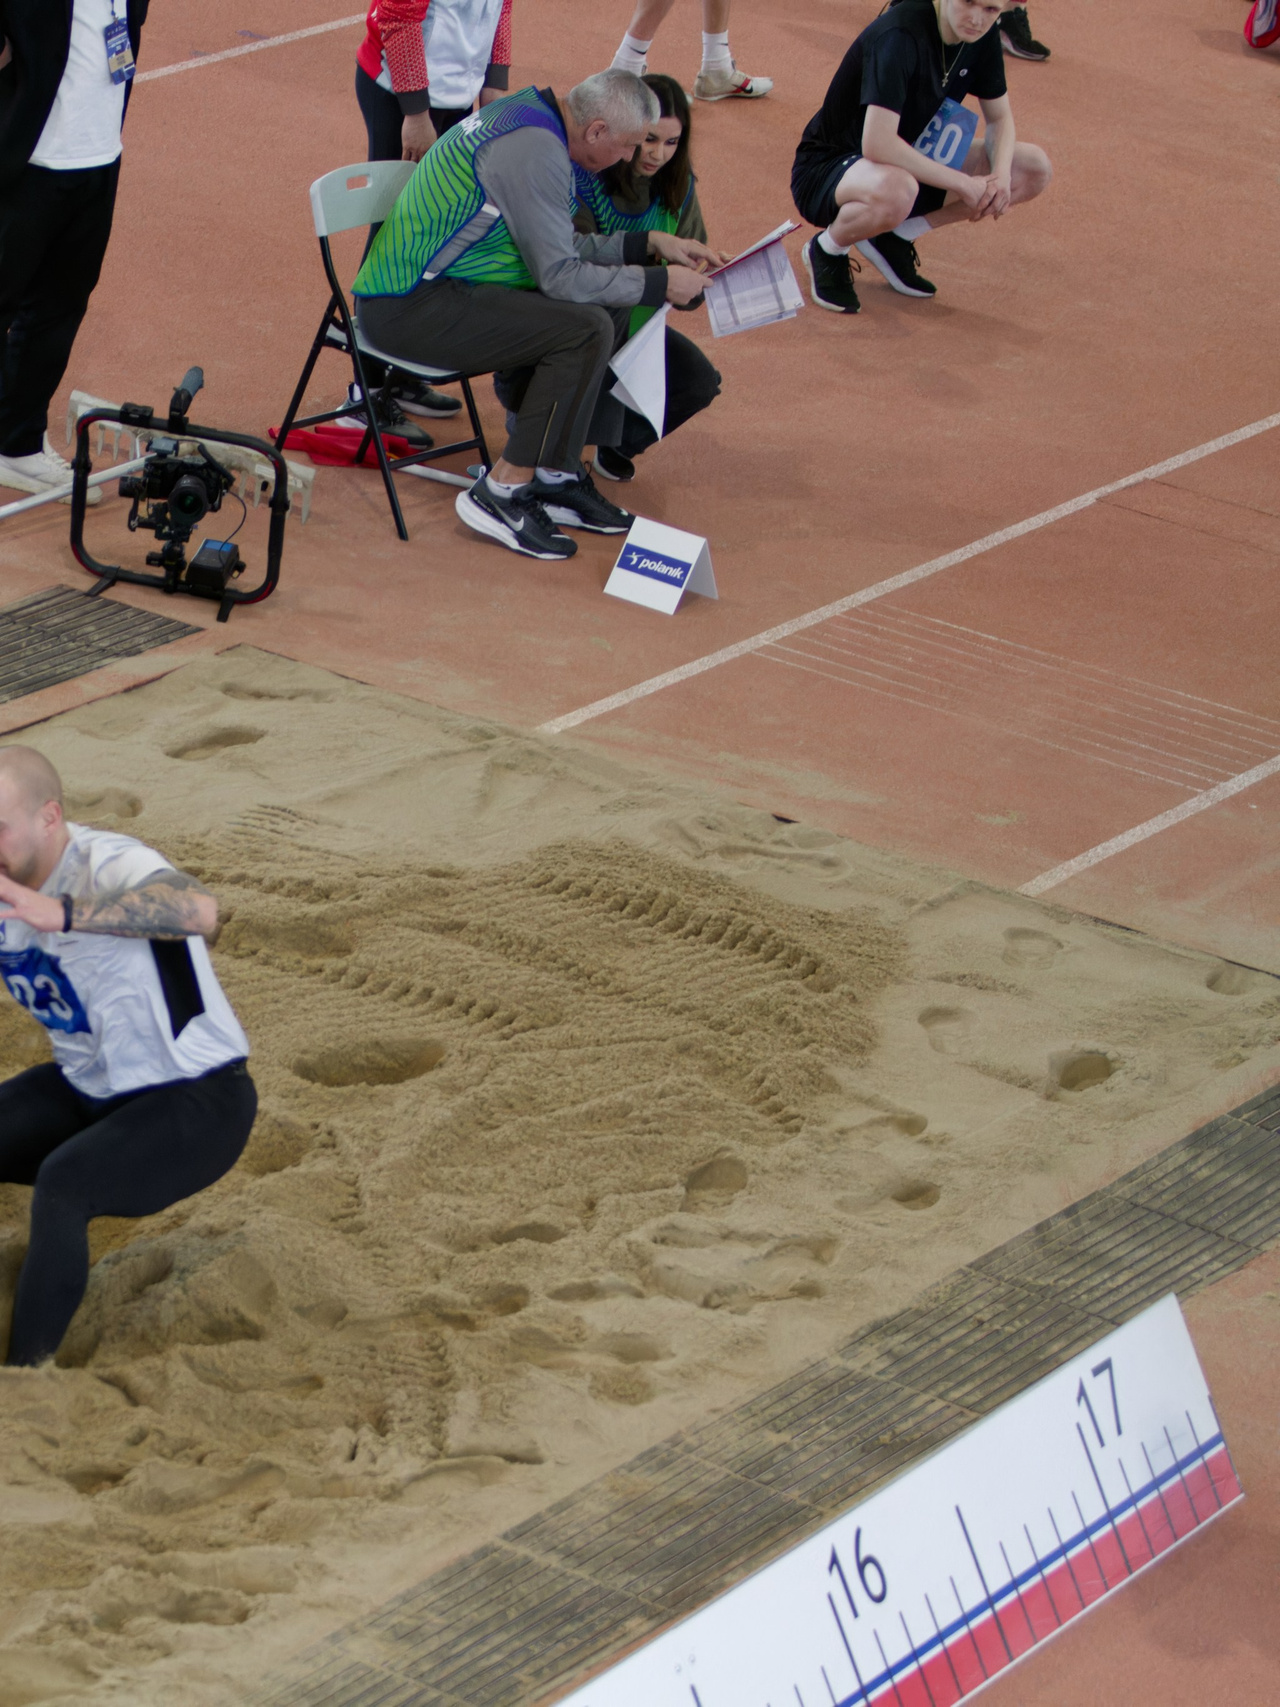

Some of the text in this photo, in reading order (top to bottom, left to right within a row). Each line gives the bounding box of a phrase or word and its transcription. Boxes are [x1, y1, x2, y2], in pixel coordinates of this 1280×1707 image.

[638, 558, 684, 580] polanik
[1077, 1356, 1122, 1448] 17
[829, 1526, 887, 1619] 16
